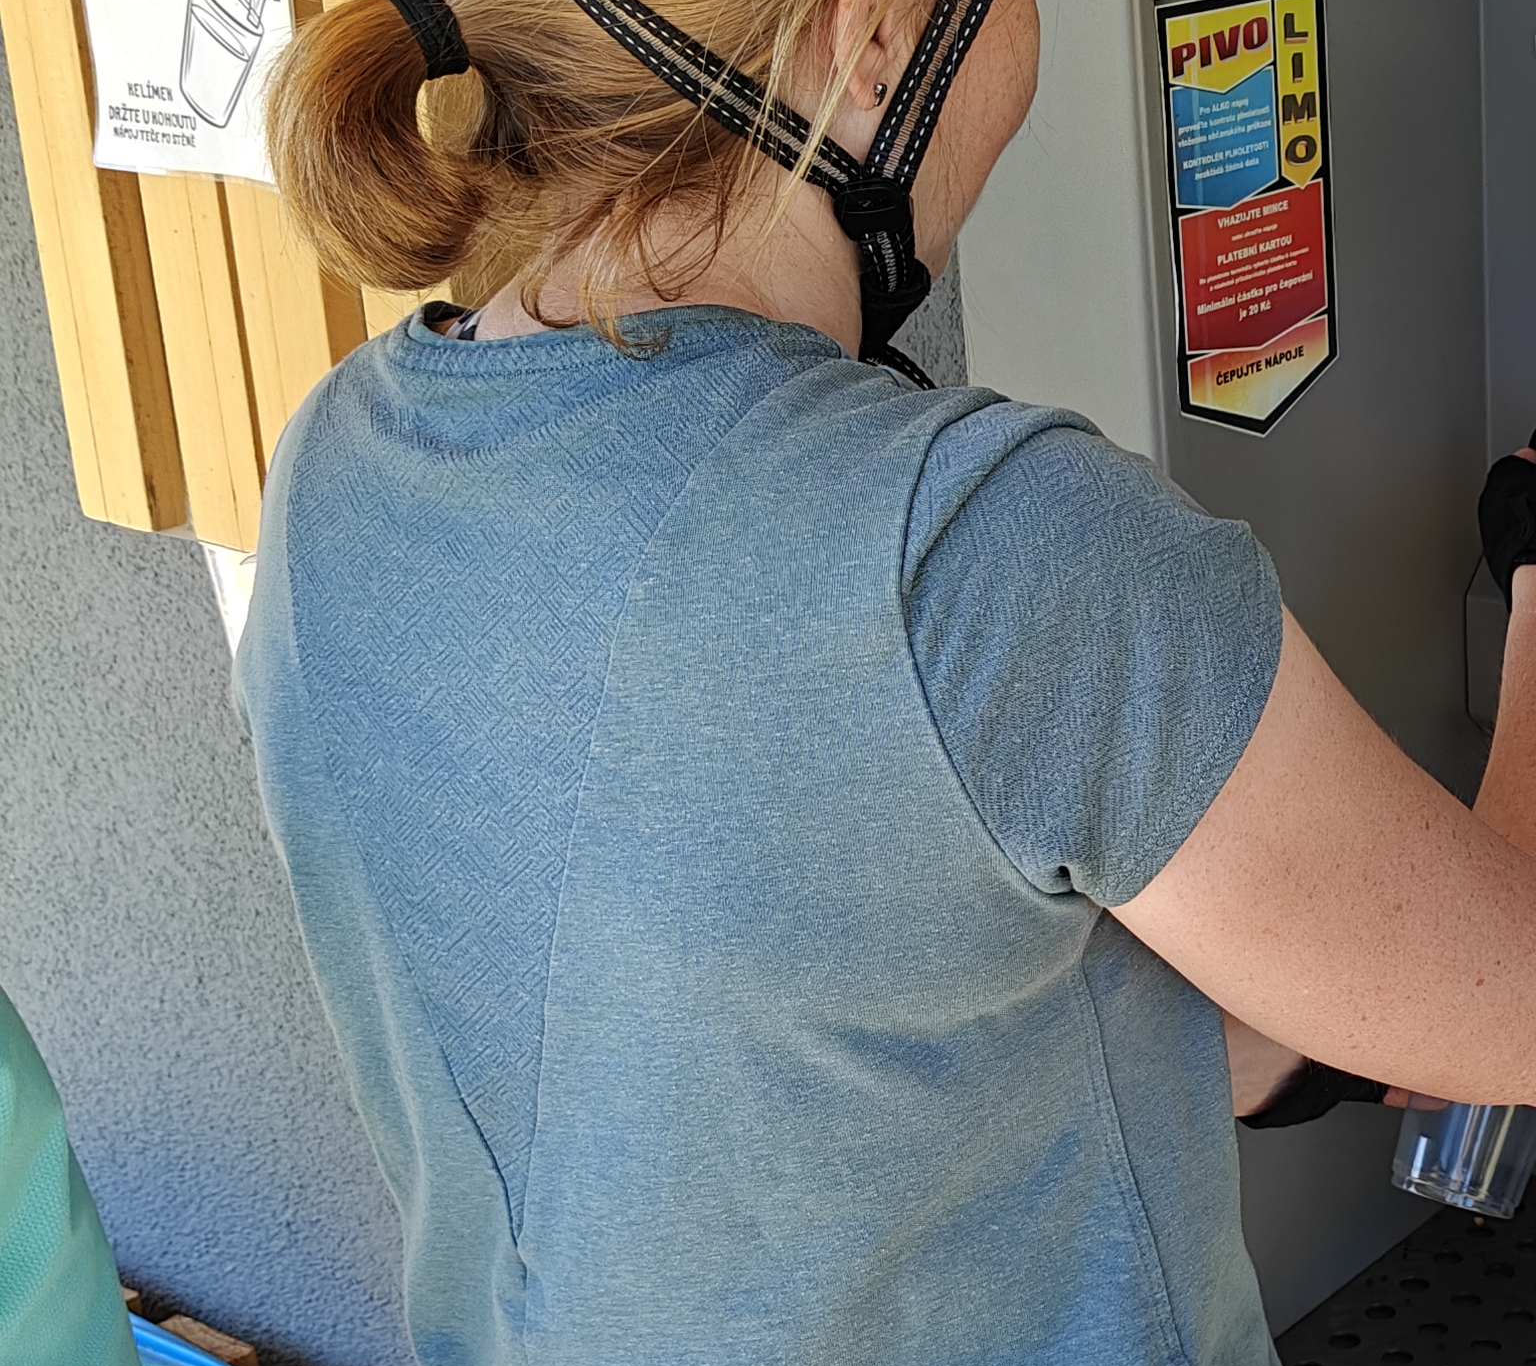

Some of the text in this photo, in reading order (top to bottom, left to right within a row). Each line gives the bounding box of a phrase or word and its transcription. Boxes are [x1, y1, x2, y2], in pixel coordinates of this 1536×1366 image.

[1171, 16, 1269, 80] PIVO
[127, 80, 173, 102] KELÍMEK
[1282, 13, 1319, 168] LIMO
[108, 102, 196, 131] DRŽTE U KOHOUTU
[113, 124, 139, 140] NÁPOJ
[139, 128, 160, 143] TEČE
[161, 132, 171, 144] PO
[1218, 199, 1289, 229] VHAZUJTE MINCE
[1217, 242, 1257, 266] PLATEBNÍ
[1259, 234, 1292, 253] KARTOU
[1248, 303, 1258, 316] 20
[1215, 345, 1304, 386] ČEPUJTE NÁPOJE
